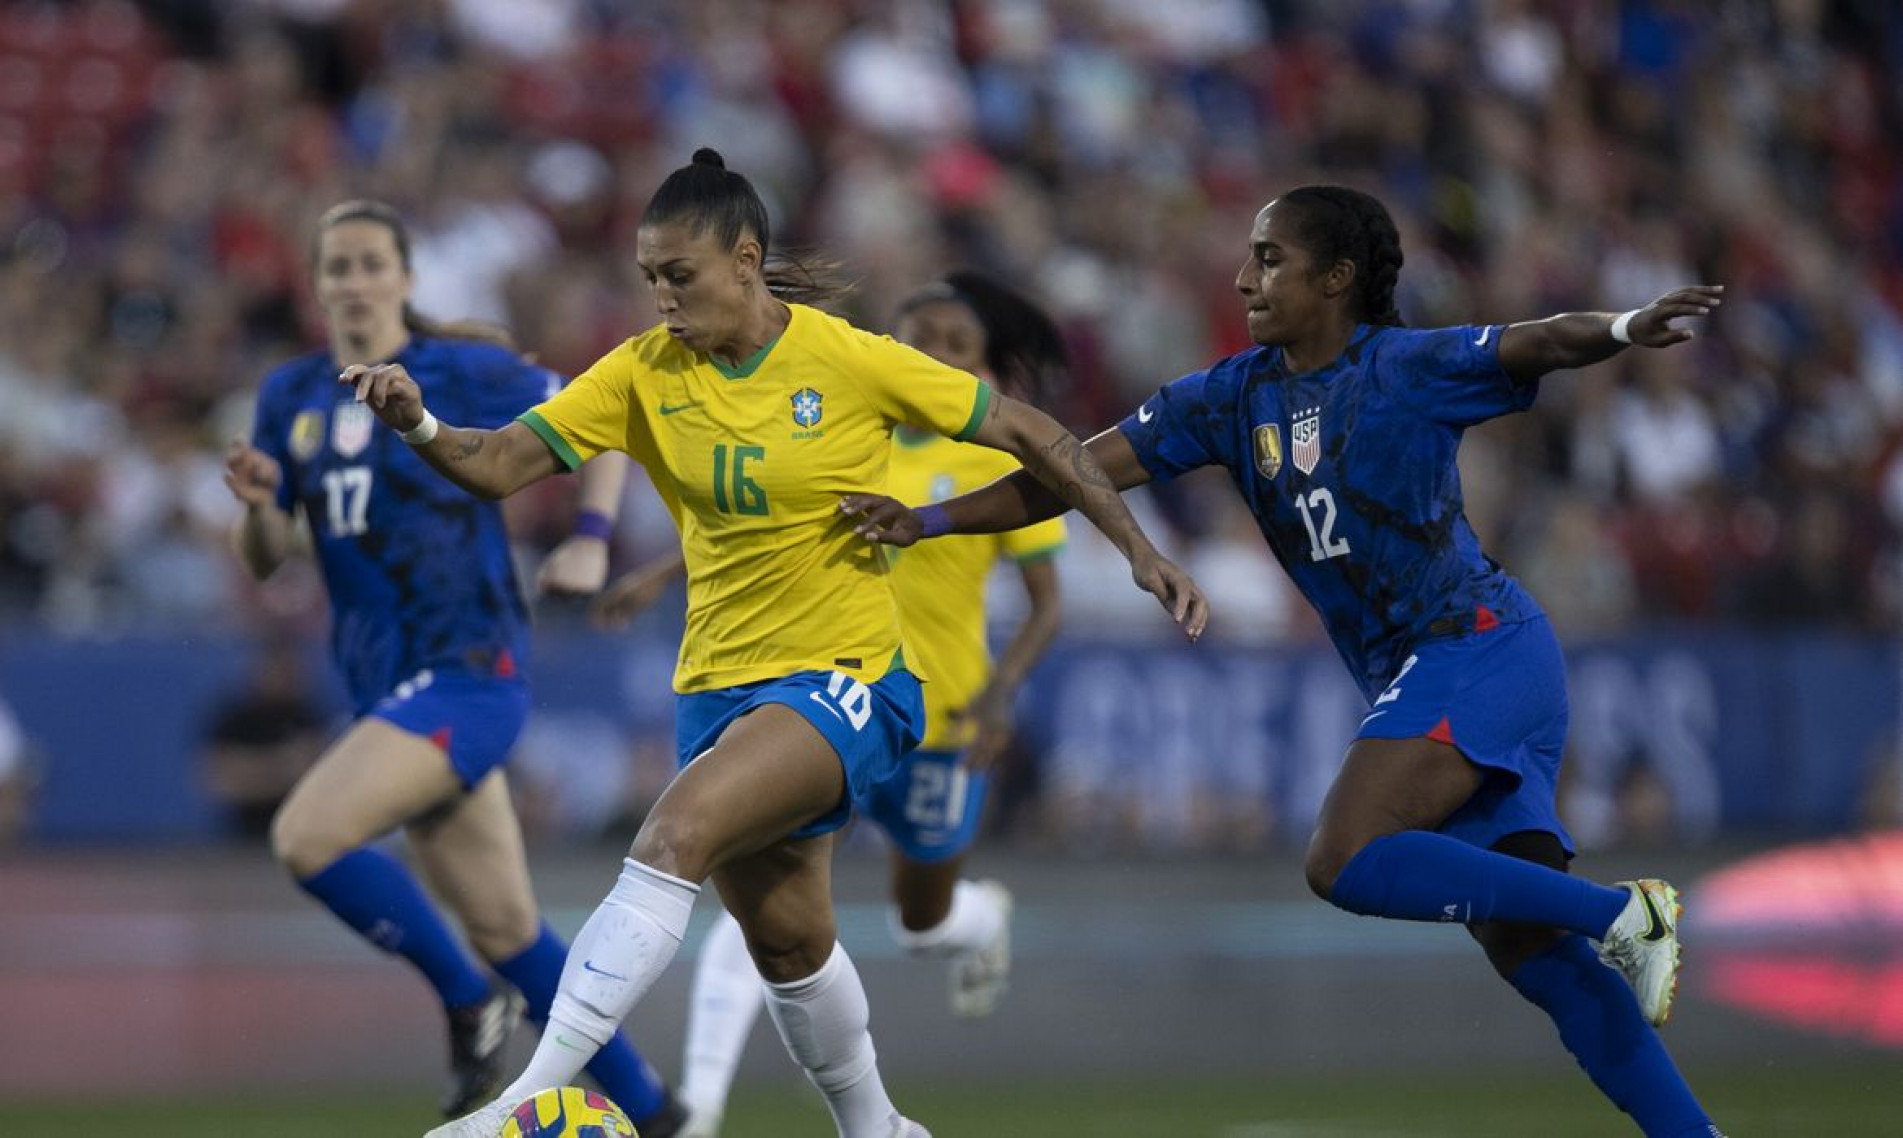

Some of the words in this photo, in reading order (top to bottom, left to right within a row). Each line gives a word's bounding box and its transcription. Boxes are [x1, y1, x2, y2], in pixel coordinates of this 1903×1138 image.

[1293, 420, 1317, 443] USA
[322, 466, 373, 538] 17
[713, 444, 770, 516] 16
[1294, 487, 1351, 562] 12
[904, 761, 969, 830] 21
